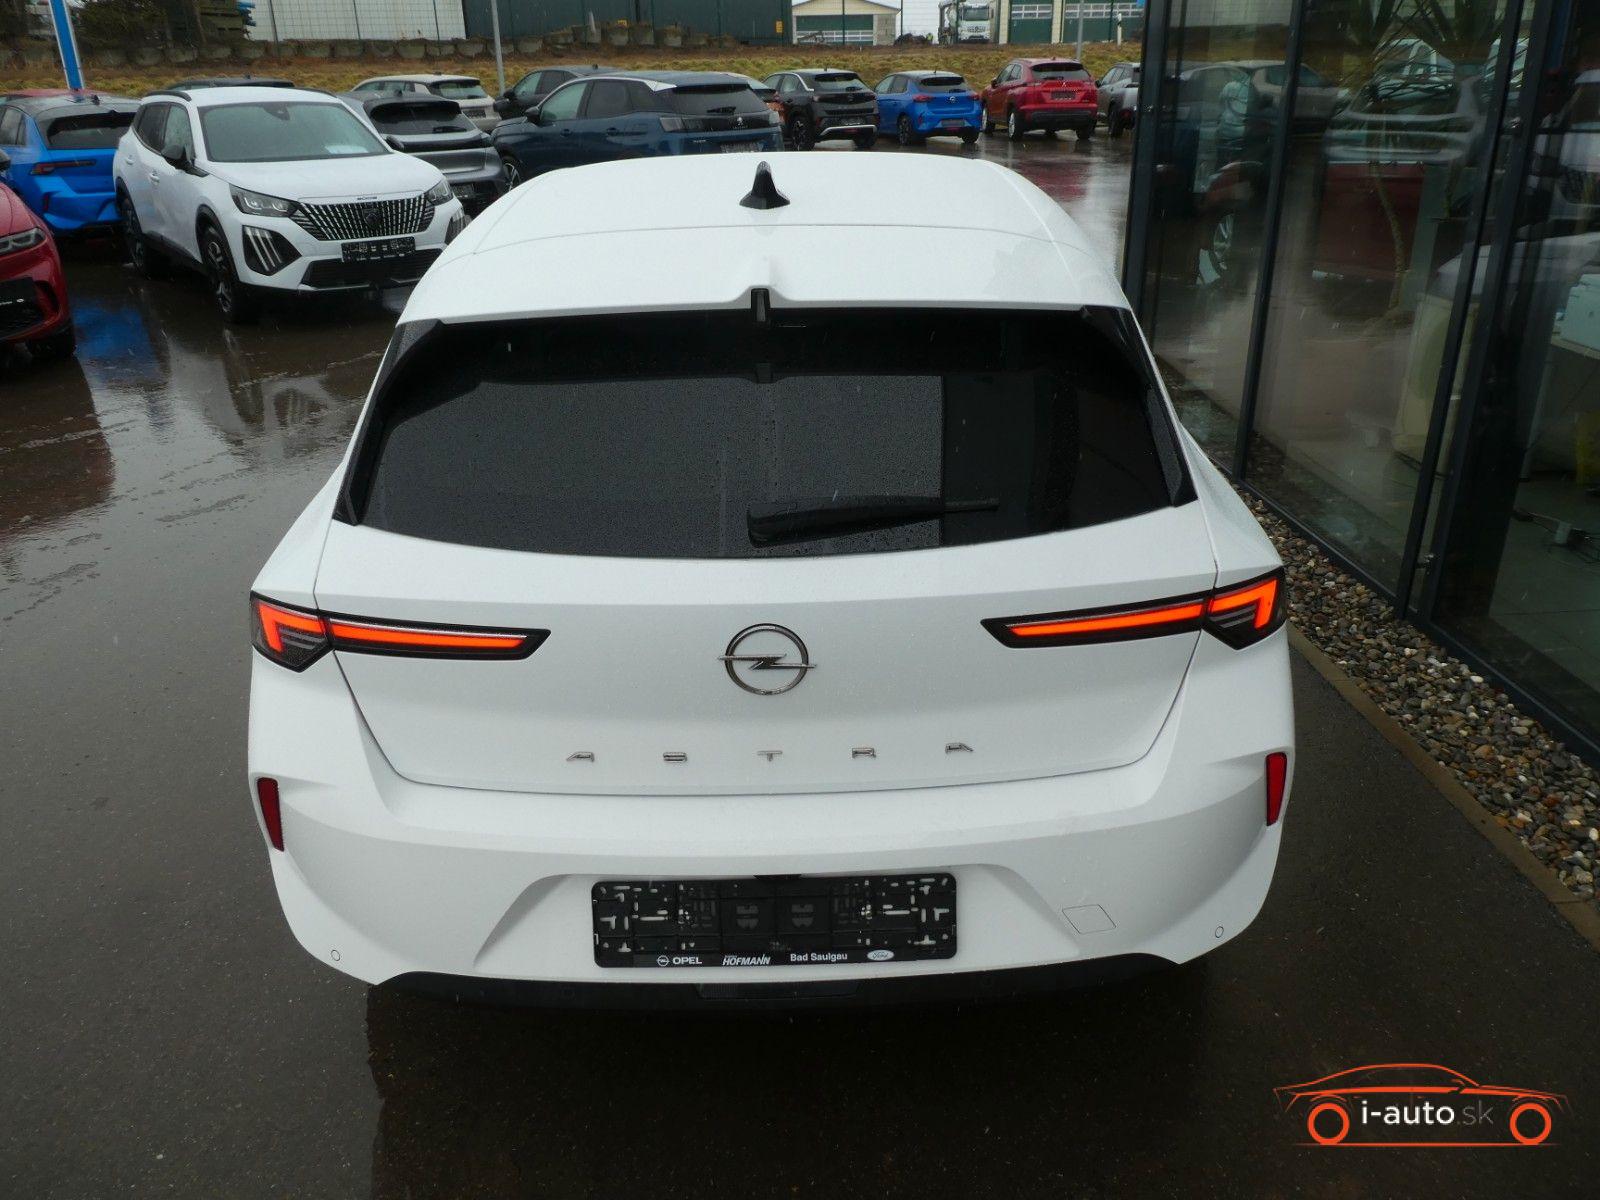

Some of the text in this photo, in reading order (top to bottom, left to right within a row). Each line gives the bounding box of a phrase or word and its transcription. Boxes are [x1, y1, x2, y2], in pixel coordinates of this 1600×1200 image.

[566, 743, 973, 762] ASTRA
[672, 956, 703, 965] OPEL
[722, 955, 771, 966] HOFMANN
[790, 952, 848, 962] Bad Saulgau
